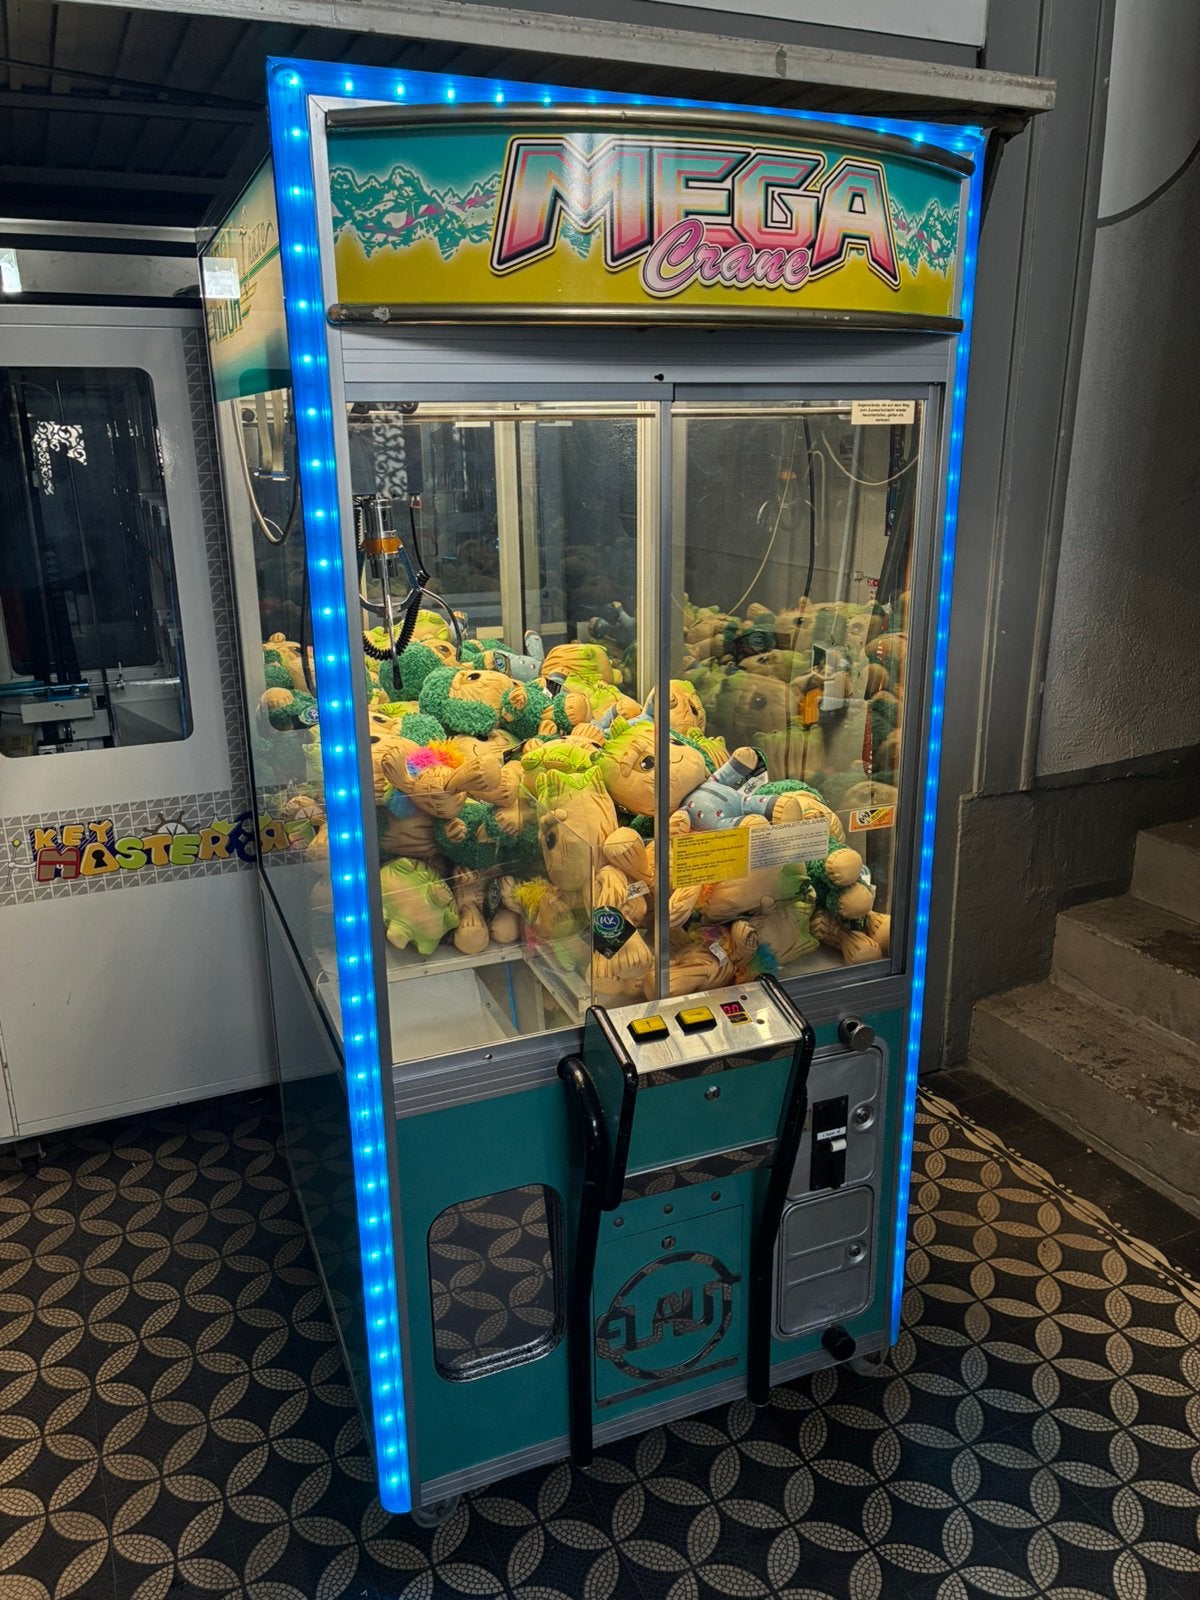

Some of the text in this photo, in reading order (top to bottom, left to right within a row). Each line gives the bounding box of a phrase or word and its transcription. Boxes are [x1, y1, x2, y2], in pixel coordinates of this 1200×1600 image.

[491, 134, 901, 290] MEGA
[639, 217, 813, 299] Crane
[35, 820, 112, 849] KEY
[36, 826, 231, 883] MASTER
